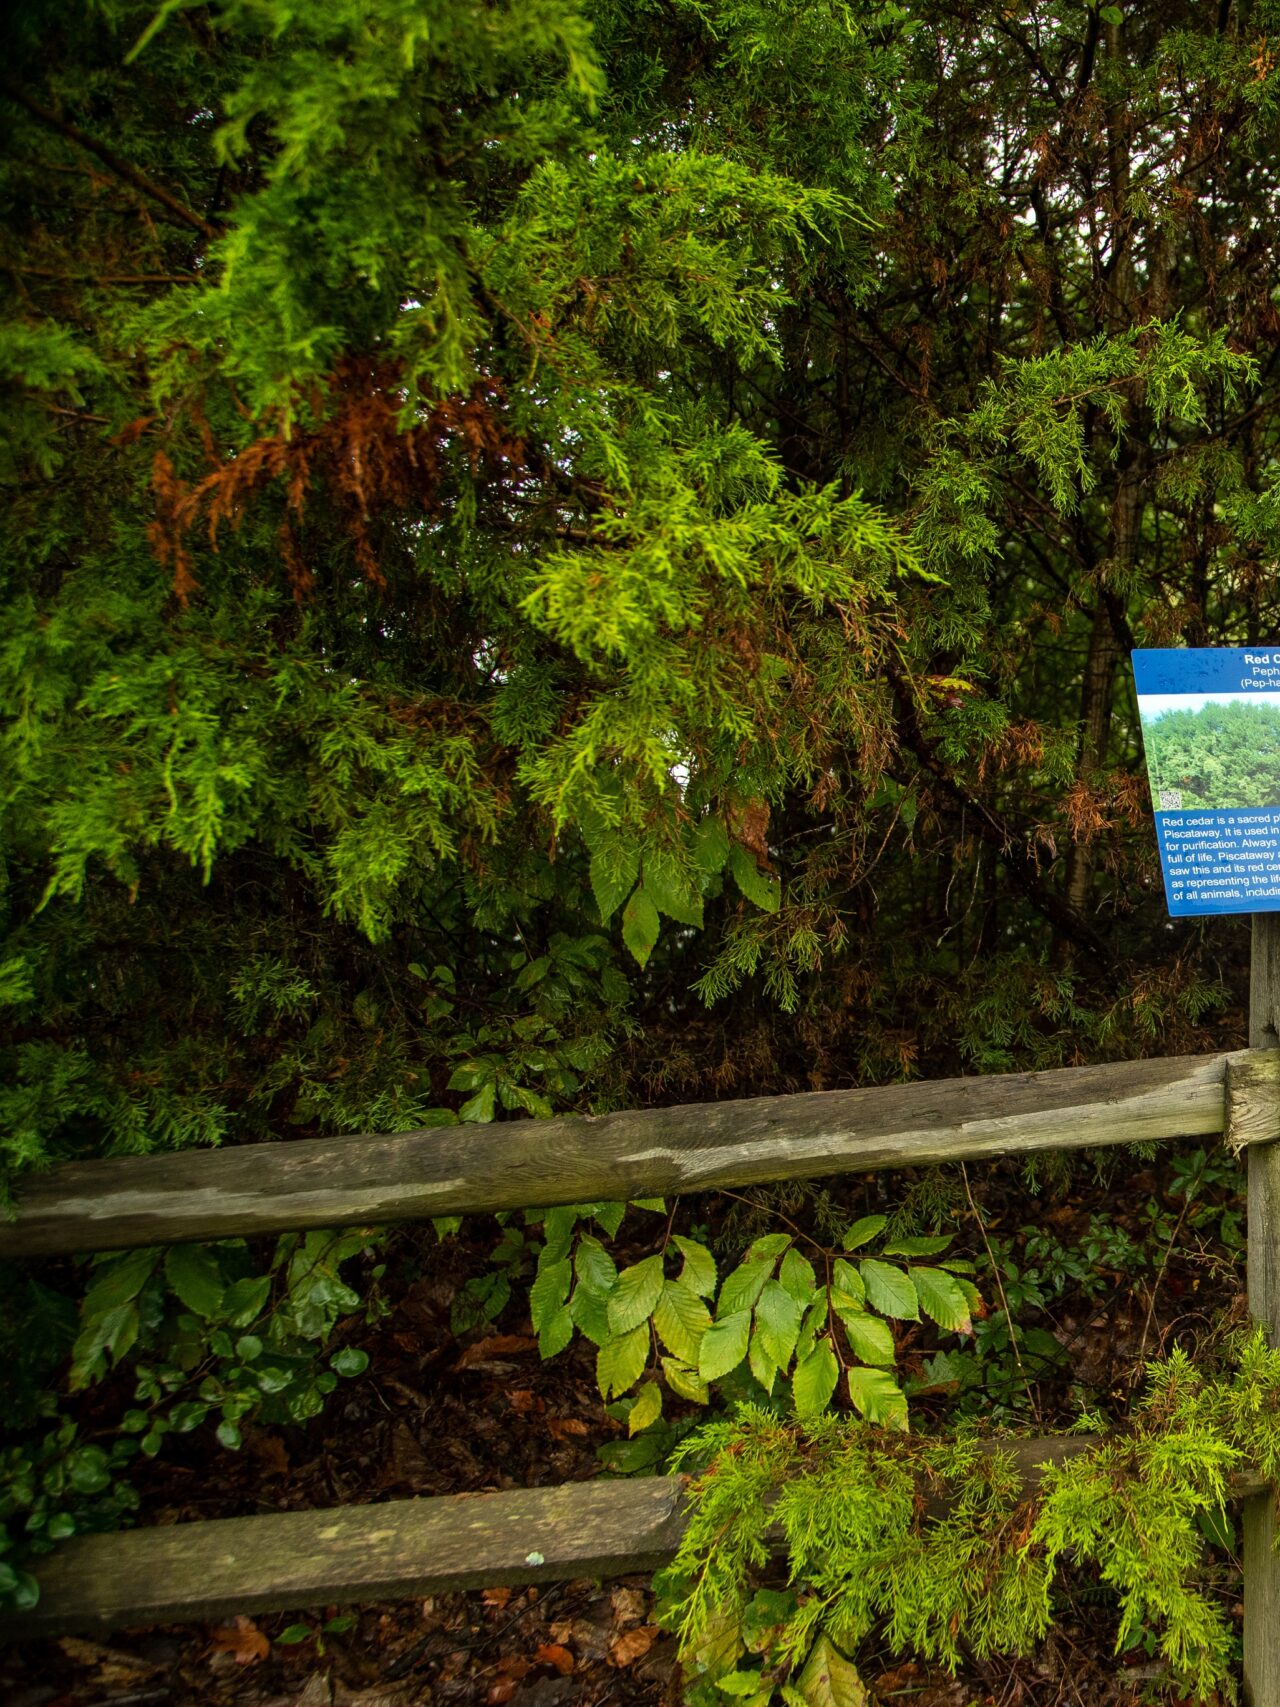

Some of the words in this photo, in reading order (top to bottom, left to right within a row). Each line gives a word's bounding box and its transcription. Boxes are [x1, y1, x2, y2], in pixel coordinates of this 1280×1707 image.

[1245, 655, 1270, 664] Red
[1163, 818, 1183, 827] Red
[1186, 817, 1214, 826] cedar
[1217, 816, 1225, 824] is
[1238, 814, 1270, 824] sacred
[1164, 829, 1222, 839] Piscataway.
[1225, 828, 1231, 836] It
[1234, 828, 1242, 836] is
[1245, 827, 1268, 836] used
[1271, 826, 1279, 834] in
[1166, 842, 1179, 851] for
[1183, 841, 1240, 852] purification.
[1242, 839, 1277, 848] Always
[1168, 854, 1182, 863] full
[1185, 854, 1195, 862] of
[1198, 853, 1215, 862] life,
[1218, 851, 1274, 861] Piscataway
[1192, 866, 1210, 875] this
[1213, 865, 1231, 874] and
[1234, 864, 1245, 872] its
[1248, 863, 1264, 872] red
[1187, 877, 1249, 888] representing
[1252, 875, 1268, 884] the
[1174, 891, 1183, 901] of
[1187, 891, 1197, 899] all
[1201, 889, 1243, 899] animals,
